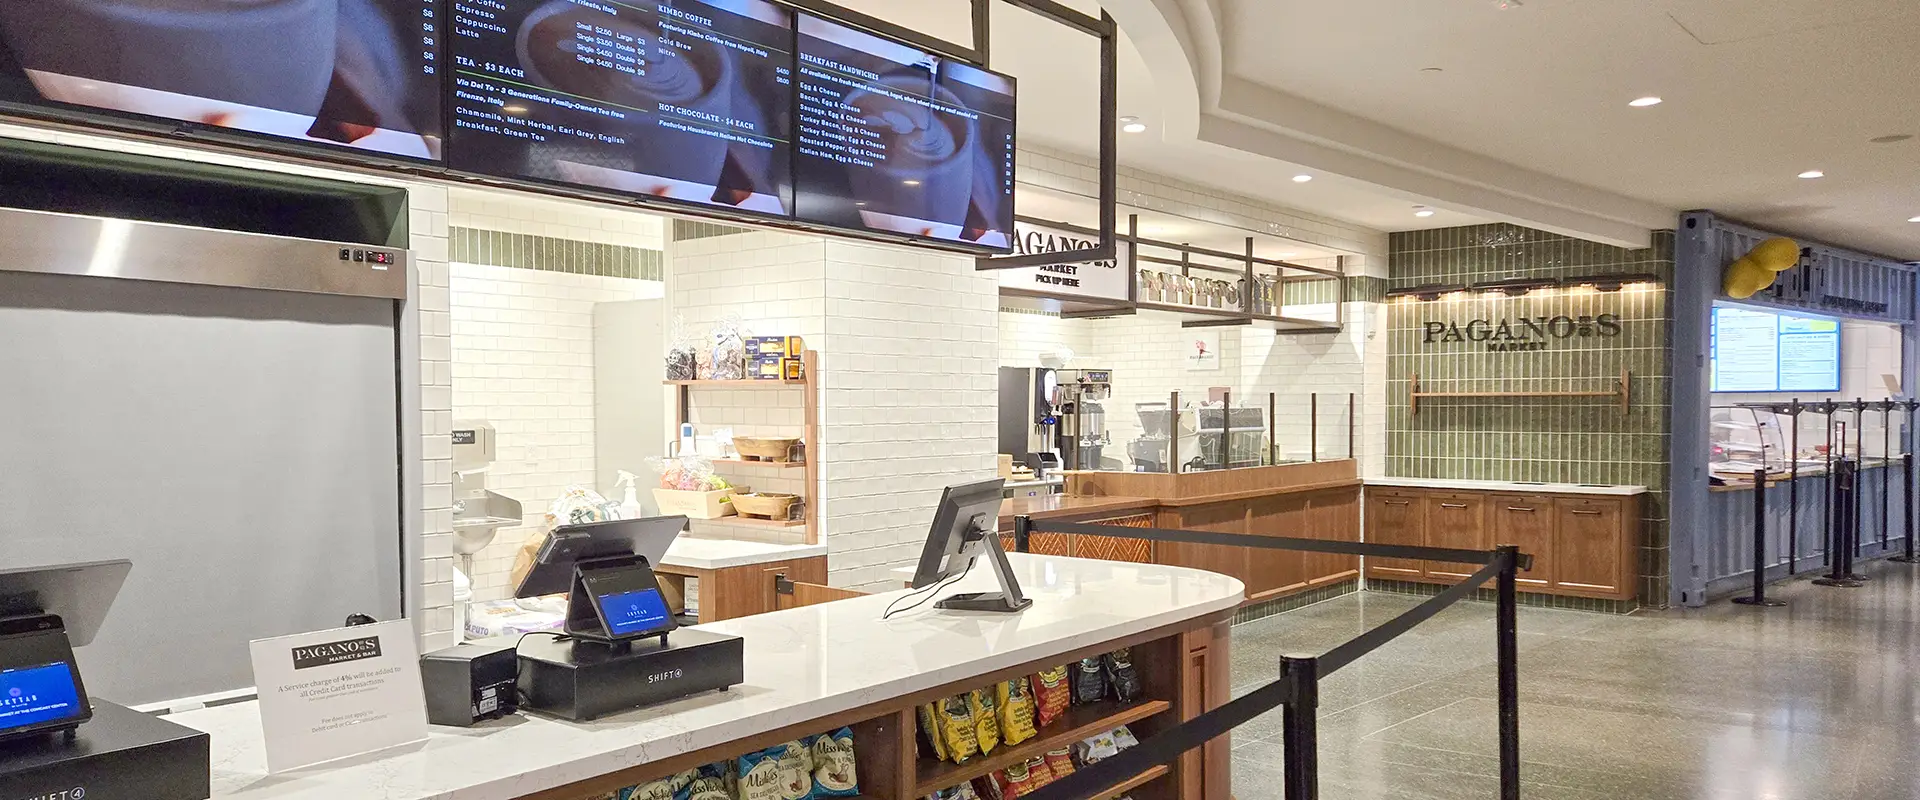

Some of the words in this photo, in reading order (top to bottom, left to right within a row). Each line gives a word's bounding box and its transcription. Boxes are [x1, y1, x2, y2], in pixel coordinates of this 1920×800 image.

[423, 9, 434, 18] $8
[455, 3, 495, 19] Espresso
[476, 0, 506, 11] Coffee
[602, 5, 617, 16] Italy
[658, 4, 683, 18] KIMBO
[685, 13, 712, 26] COFFEE
[423, 23, 434, 32] $8
[455, 15, 507, 34] Cappuccino
[455, 26, 480, 38] Latte
[576, 22, 592, 31] Small
[595, 26, 612, 36] $2.50
[616, 32, 634, 42] Large
[638, 37, 646, 46] $3
[658, 21, 686, 36] Featuring
[687, 30, 704, 40] Kimbo
[705, 35, 724, 45] Coffee
[725, 40, 737, 48] from
[423, 37, 434, 46] $8
[576, 32, 594, 42] Single
[596, 37, 613, 48] $3.50
[616, 42, 636, 53] Double
[658, 36, 674, 46] Cold
[676, 41, 692, 50] Brew
[423, 51, 434, 60] $8
[576, 44, 594, 54] Single
[596, 48, 613, 58] $4.50
[616, 53, 636, 64] Double
[658, 48, 676, 58] Nitro
[423, 65, 434, 75] $8
[455, 56, 476, 68] TEA
[485, 62, 496, 72] $3
[498, 65, 524, 78] EACH
[576, 54, 594, 64] Single
[596, 58, 613, 68] $4.50
[616, 64, 636, 74] Double
[800, 52, 838, 69] BREAKFAST
[839, 62, 879, 80] SANDWICHES
[800, 82, 811, 92] Egg
[818, 87, 840, 98] Cheese
[808, 70, 831, 80] available
[839, 76, 852, 86] fresh
[852, 82, 866, 90] baked
[456, 78, 469, 87] Via
[470, 80, 483, 90] Del
[508, 88, 550, 104] Generations
[550, 98, 598, 114] Family-Owned
[598, 107, 610, 116] Tea
[610, 110, 625, 119] from
[456, 90, 486, 104] Firenze,
[487, 96, 504, 107] Italy
[800, 92, 820, 104] Bacon,
[822, 98, 832, 108] Egg
[840, 102, 860, 113] Cheese
[658, 102, 675, 113] HOT
[676, 107, 720, 122] CHOCOLATE
[726, 118, 734, 126] $4
[736, 120, 754, 130] EACH
[800, 104, 826, 116] Sausage,
[828, 110, 839, 120] Egg
[846, 114, 866, 125] Cheese
[456, 106, 504, 122] Chamomile,
[507, 116, 526, 126] Mint
[528, 120, 557, 132] Herbal,
[559, 126, 574, 135] Earl
[576, 128, 597, 140] Grey,
[598, 134, 625, 144] English
[456, 119, 501, 135] Breakfast,
[504, 128, 528, 138] Green
[530, 132, 545, 142] Tea
[658, 120, 686, 132] Featuring
[687, 125, 719, 138] Hausbrandt
[747, 138, 774, 148] Chocolate
[800, 114, 820, 126] Turkey
[821, 120, 840, 130] Bacon,
[842, 124, 853, 134] Egg
[860, 128, 880, 138] Cheese
[800, 125, 820, 136] Turkey
[821, 130, 847, 142] Sausage,
[848, 136, 859, 145] Egg
[866, 140, 886, 150] Cheese
[800, 136, 824, 147] Roasted
[825, 141, 847, 152] Pepper,
[848, 146, 859, 155] Egg
[866, 150, 886, 160] Cheese
[800, 147, 819, 156] Italian
[820, 150, 834, 160] Ham,
[836, 154, 846, 164] Egg
[853, 158, 874, 168] Cheese
[1040, 264, 1078, 275] MARKET
[1036, 274, 1052, 284] PICK
[1052, 276, 1062, 284] UP
[1062, 278, 1080, 287] HERE
[1488, 342, 1548, 352] MARKET
[329, 654, 356, 662] MARKET
[284, 681, 309, 692] Service
[310, 677, 332, 688] charge
[332, 676, 340, 684] of
[340, 674, 352, 682] 4%
[354, 671, 366, 680] will
[366, 670, 374, 678] be
[374, 668, 394, 676] added
[300, 690, 308, 698] all
[309, 686, 330, 697] Credit
[330, 683, 346, 692] Card
[346, 678, 385, 690] transactions
[817, 741, 836, 756] Miss
